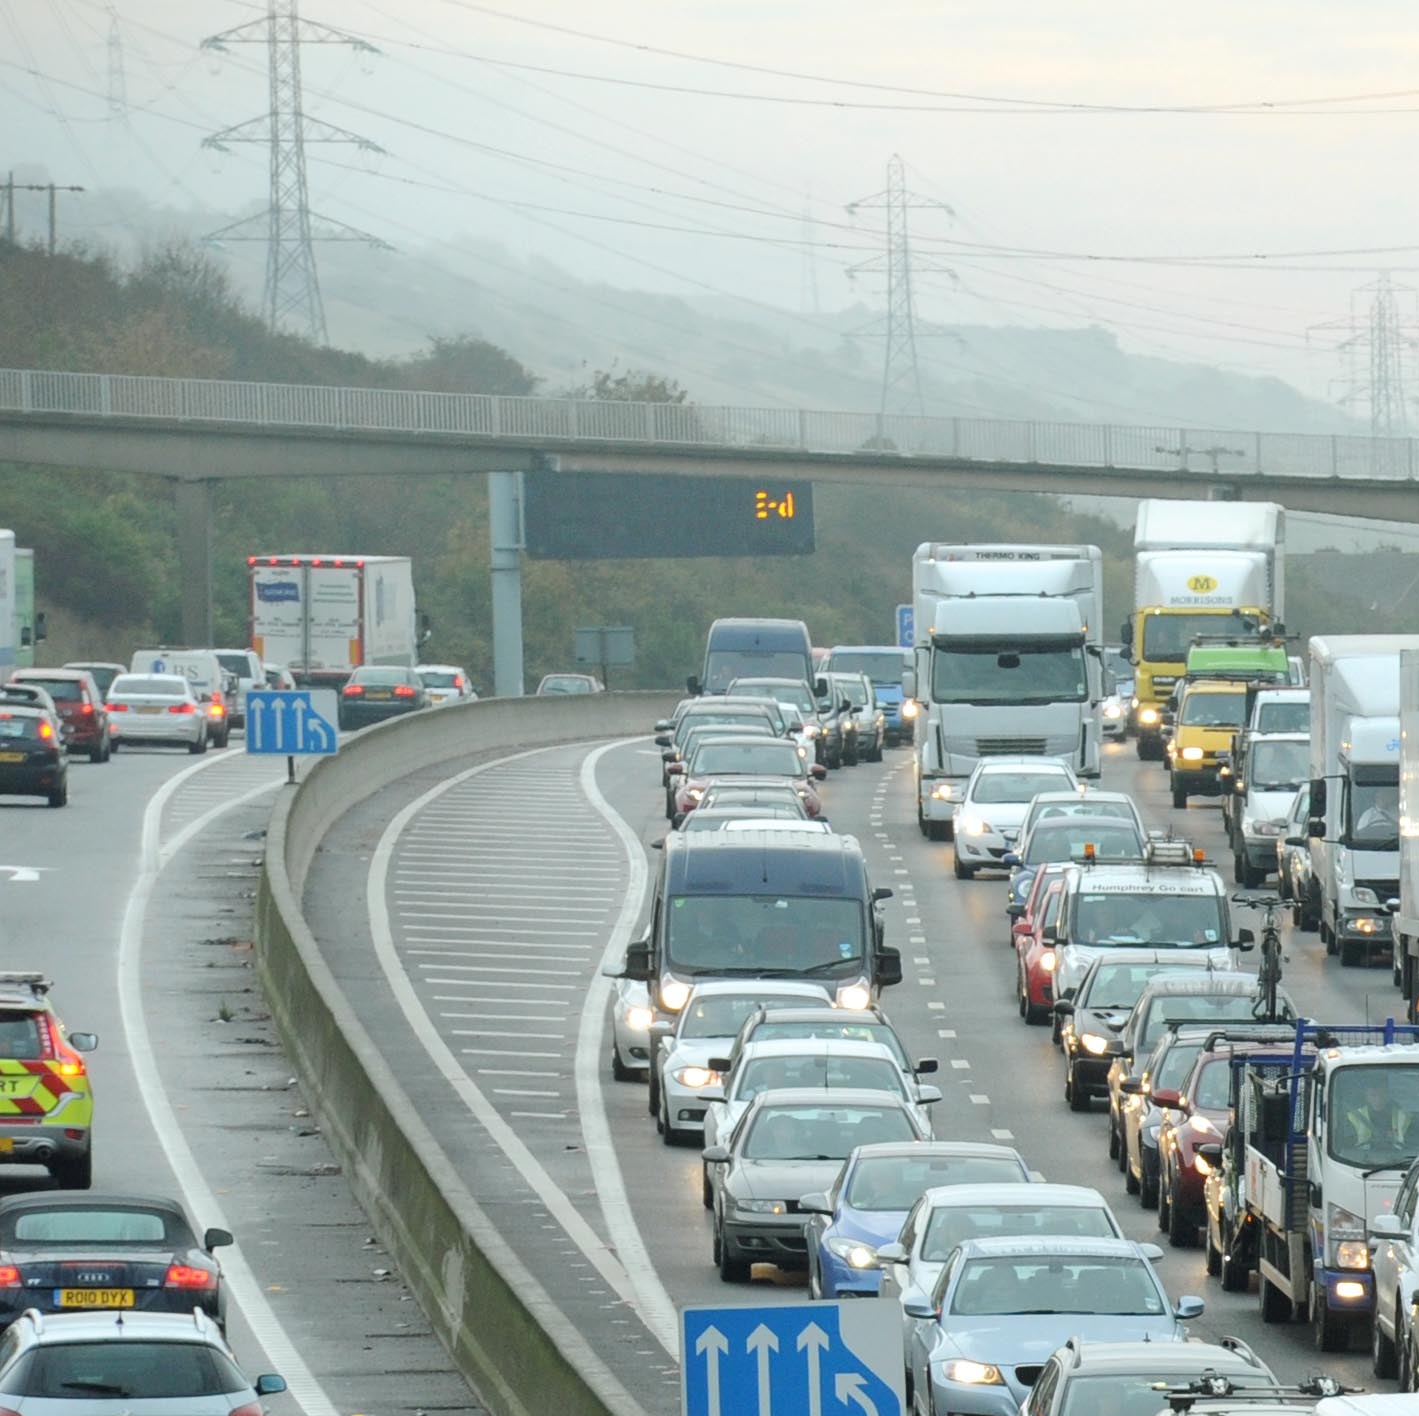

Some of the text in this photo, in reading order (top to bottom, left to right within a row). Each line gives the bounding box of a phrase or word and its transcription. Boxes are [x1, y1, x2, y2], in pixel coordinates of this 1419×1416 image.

[975, 551, 1014, 560] THERMO
[1018, 552, 1040, 561] KING
[1193, 576, 1211, 591] M
[101, 1291, 128, 1303] DYX
